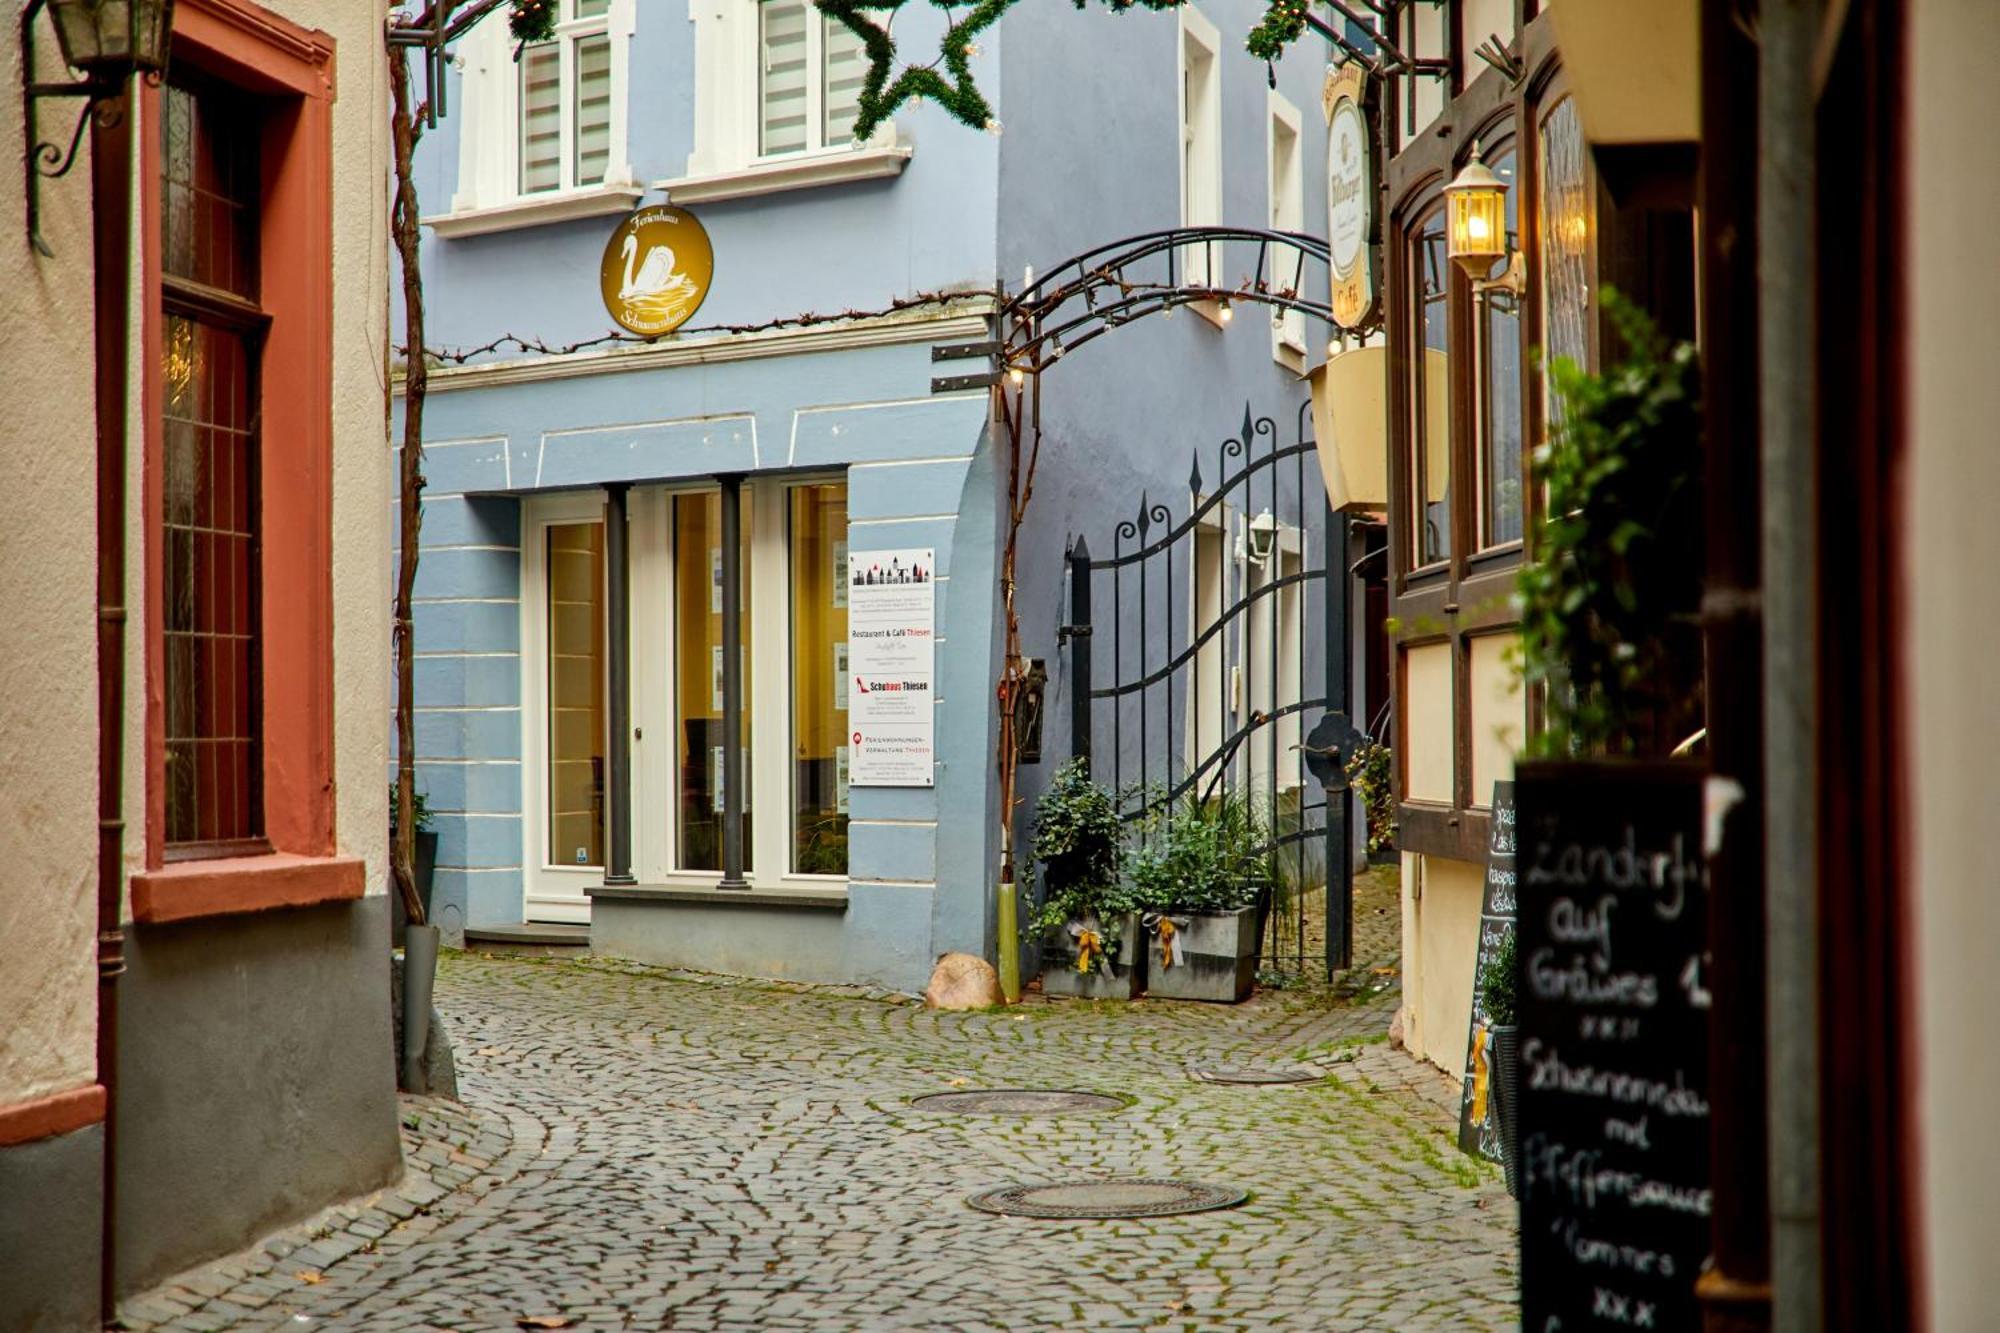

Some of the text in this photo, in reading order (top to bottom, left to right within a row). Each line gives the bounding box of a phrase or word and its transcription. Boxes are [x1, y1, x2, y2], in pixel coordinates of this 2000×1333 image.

[630, 209, 679, 234] Ferienhaus
[852, 627, 931, 638] Restaurant & Café Thiesen
[870, 681, 928, 692] Schuhaus Thiesen
[1550, 893, 1618, 973] auf
